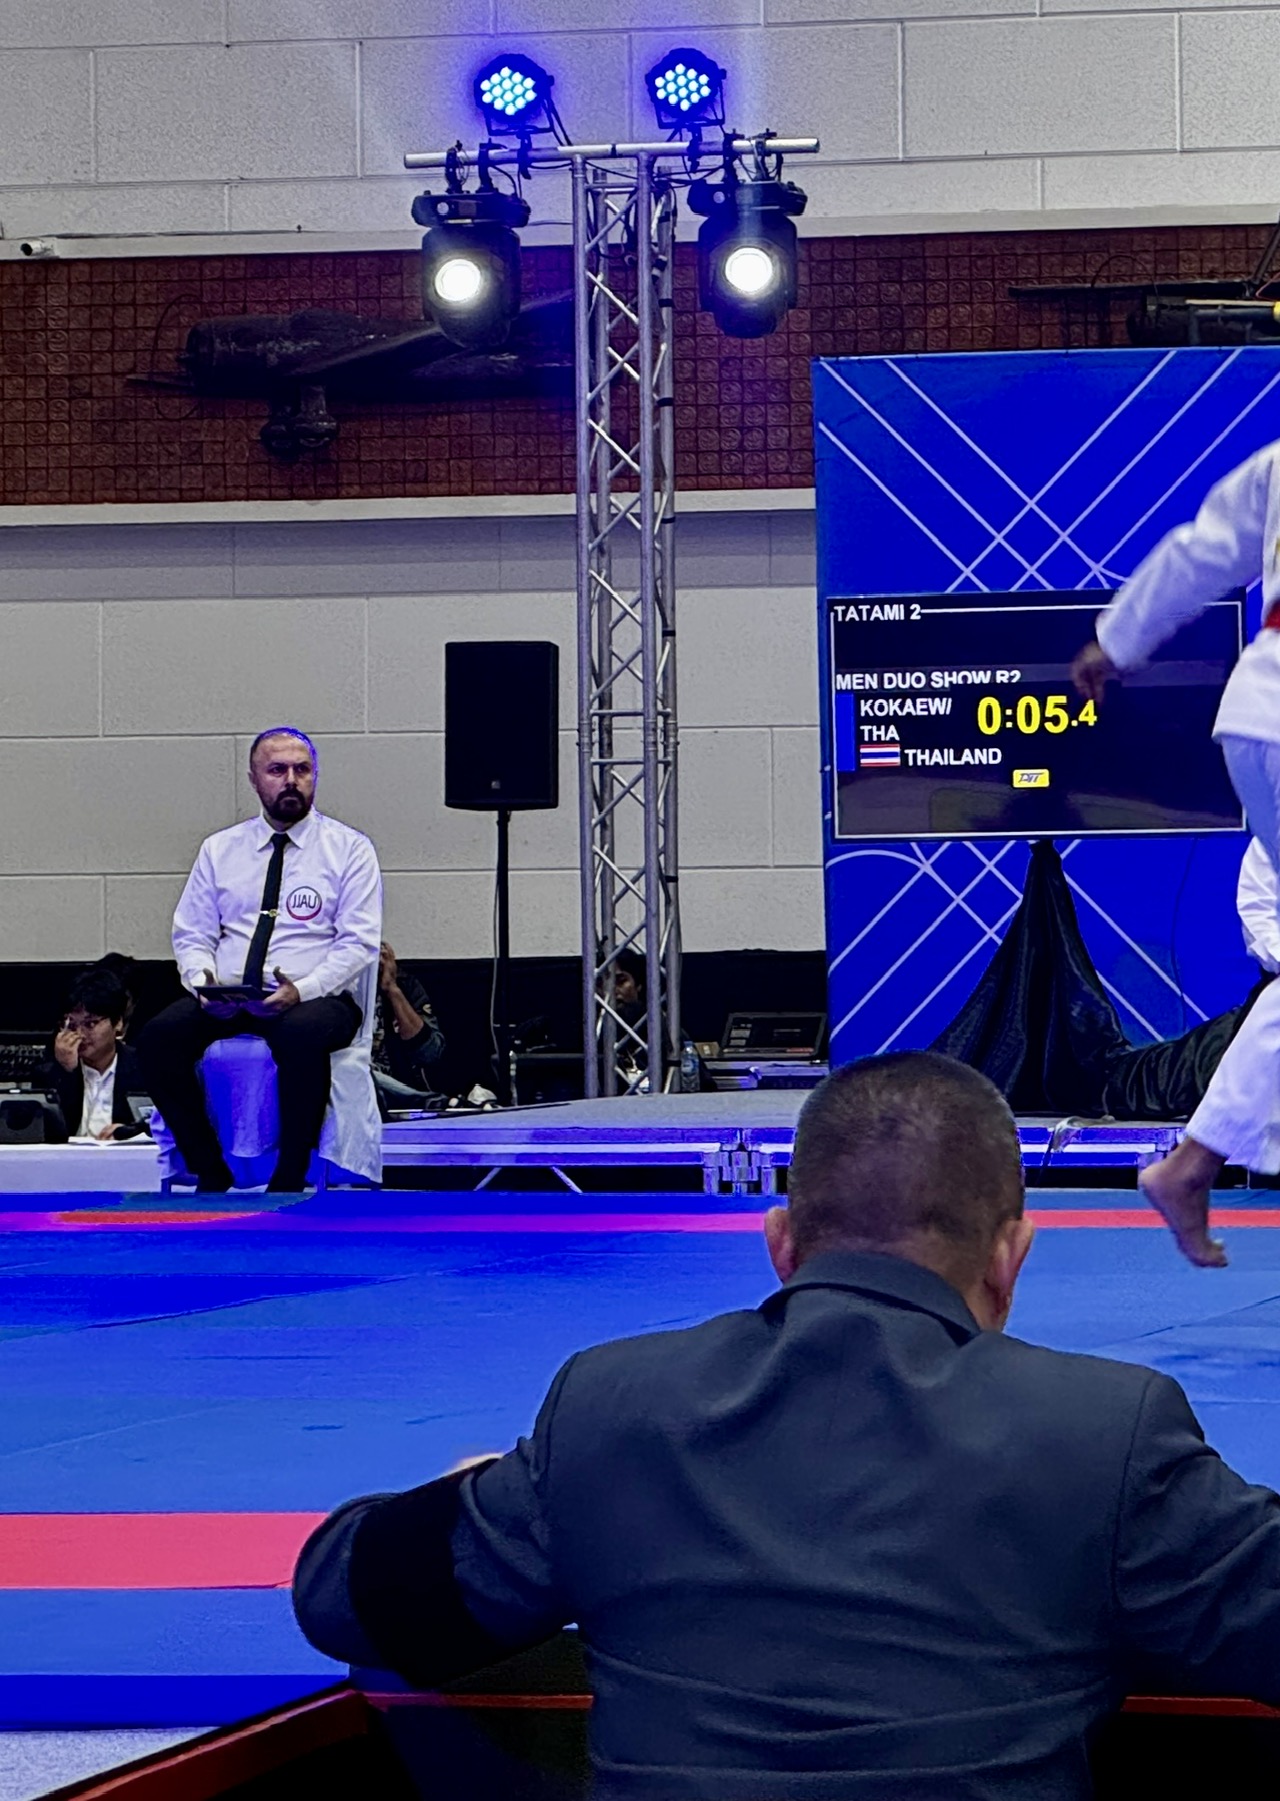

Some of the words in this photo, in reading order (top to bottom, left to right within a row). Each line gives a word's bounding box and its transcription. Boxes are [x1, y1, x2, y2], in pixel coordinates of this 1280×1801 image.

[833, 604, 905, 622] TATAMI
[909, 603, 921, 620] 2
[836, 673, 878, 690] MEN
[883, 672, 926, 689] DUO
[930, 670, 991, 688] SHOW
[860, 697, 952, 717] KOKAEW/
[977, 695, 1098, 735] 0:05.4
[860, 724, 900, 742] THA
[904, 748, 1002, 766] THAILAND
[292, 894, 318, 909] JJAU
